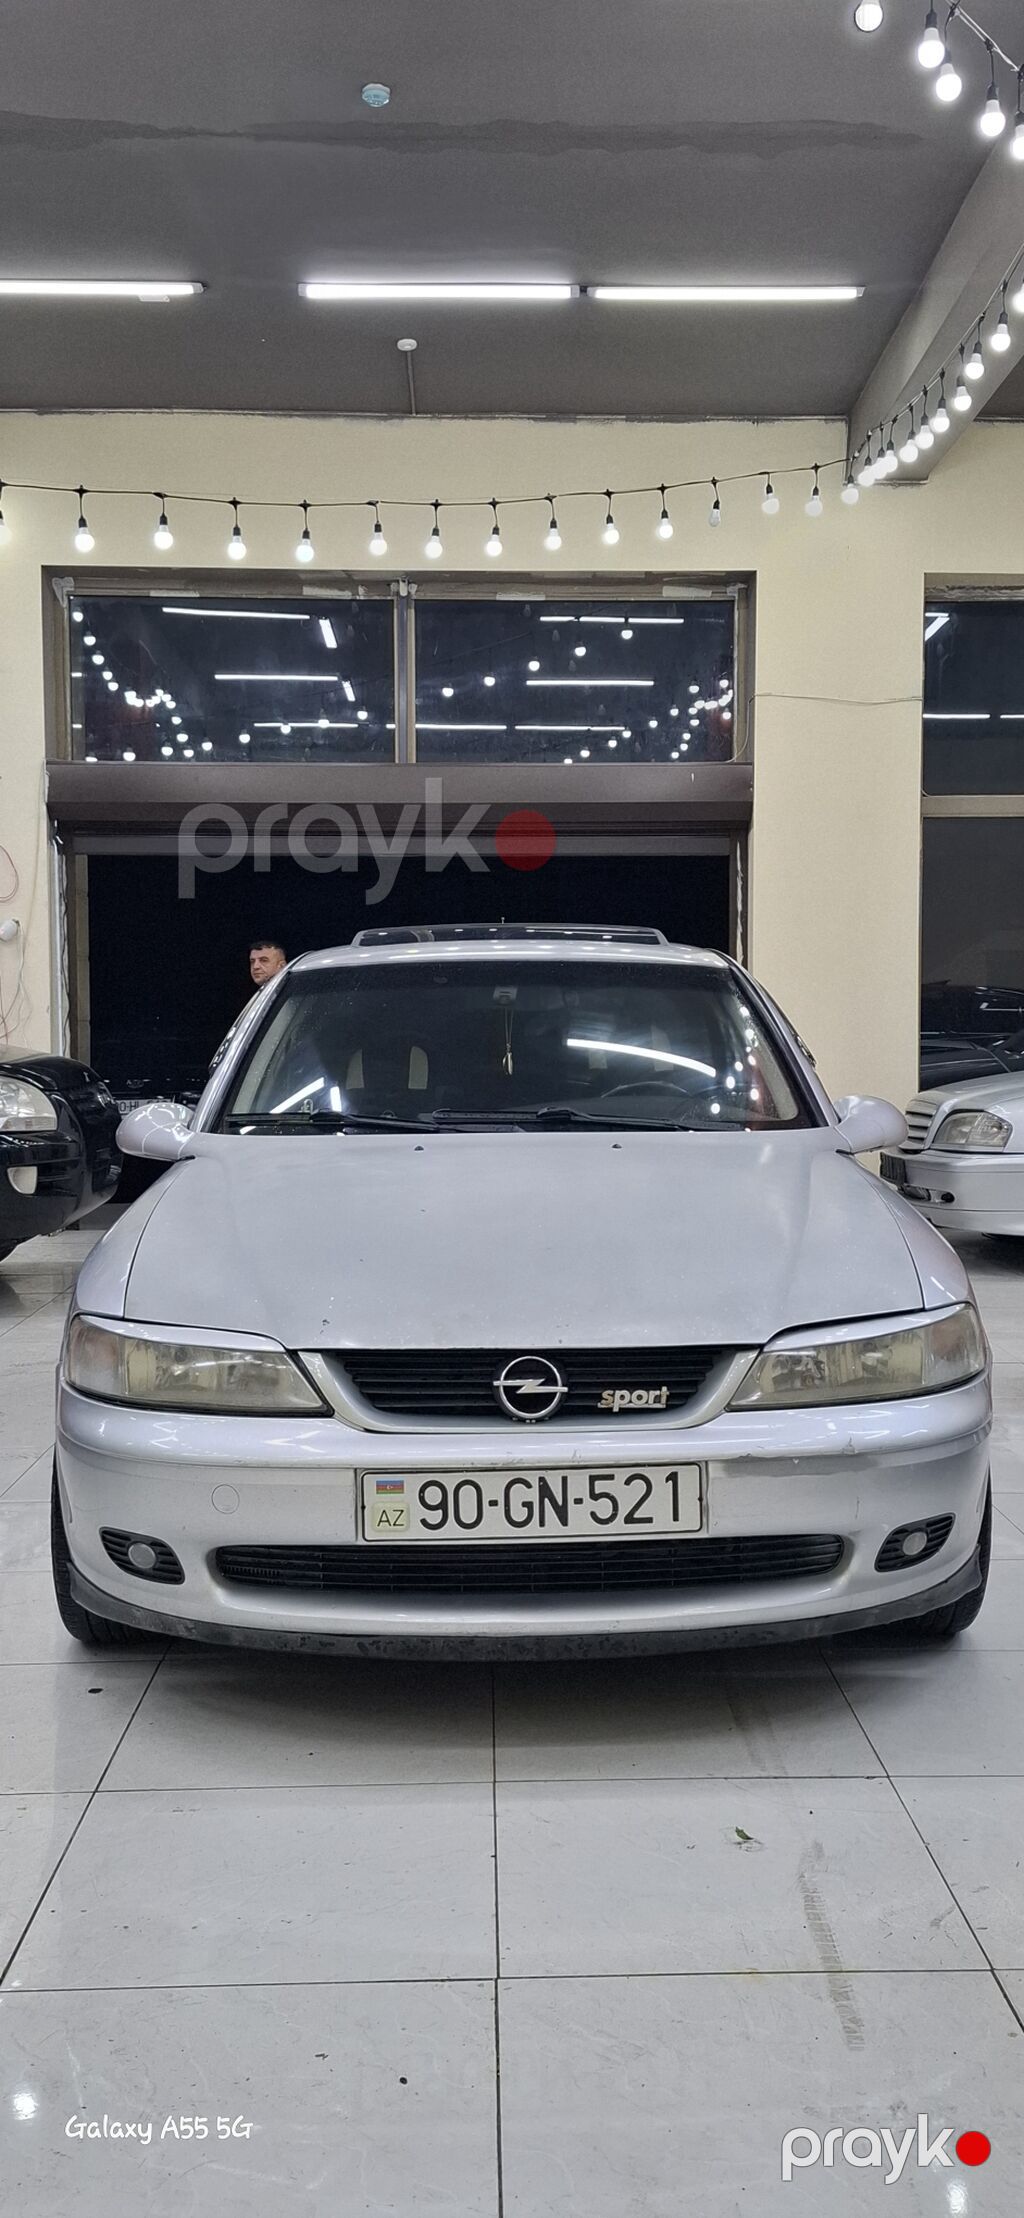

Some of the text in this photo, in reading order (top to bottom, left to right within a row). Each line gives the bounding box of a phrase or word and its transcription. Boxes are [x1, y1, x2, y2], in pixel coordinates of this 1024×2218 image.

[600, 1386, 670, 1412] sport
[417, 1470, 680, 1531] 90-GN-521
[376, 1509, 405, 1528] AZ
